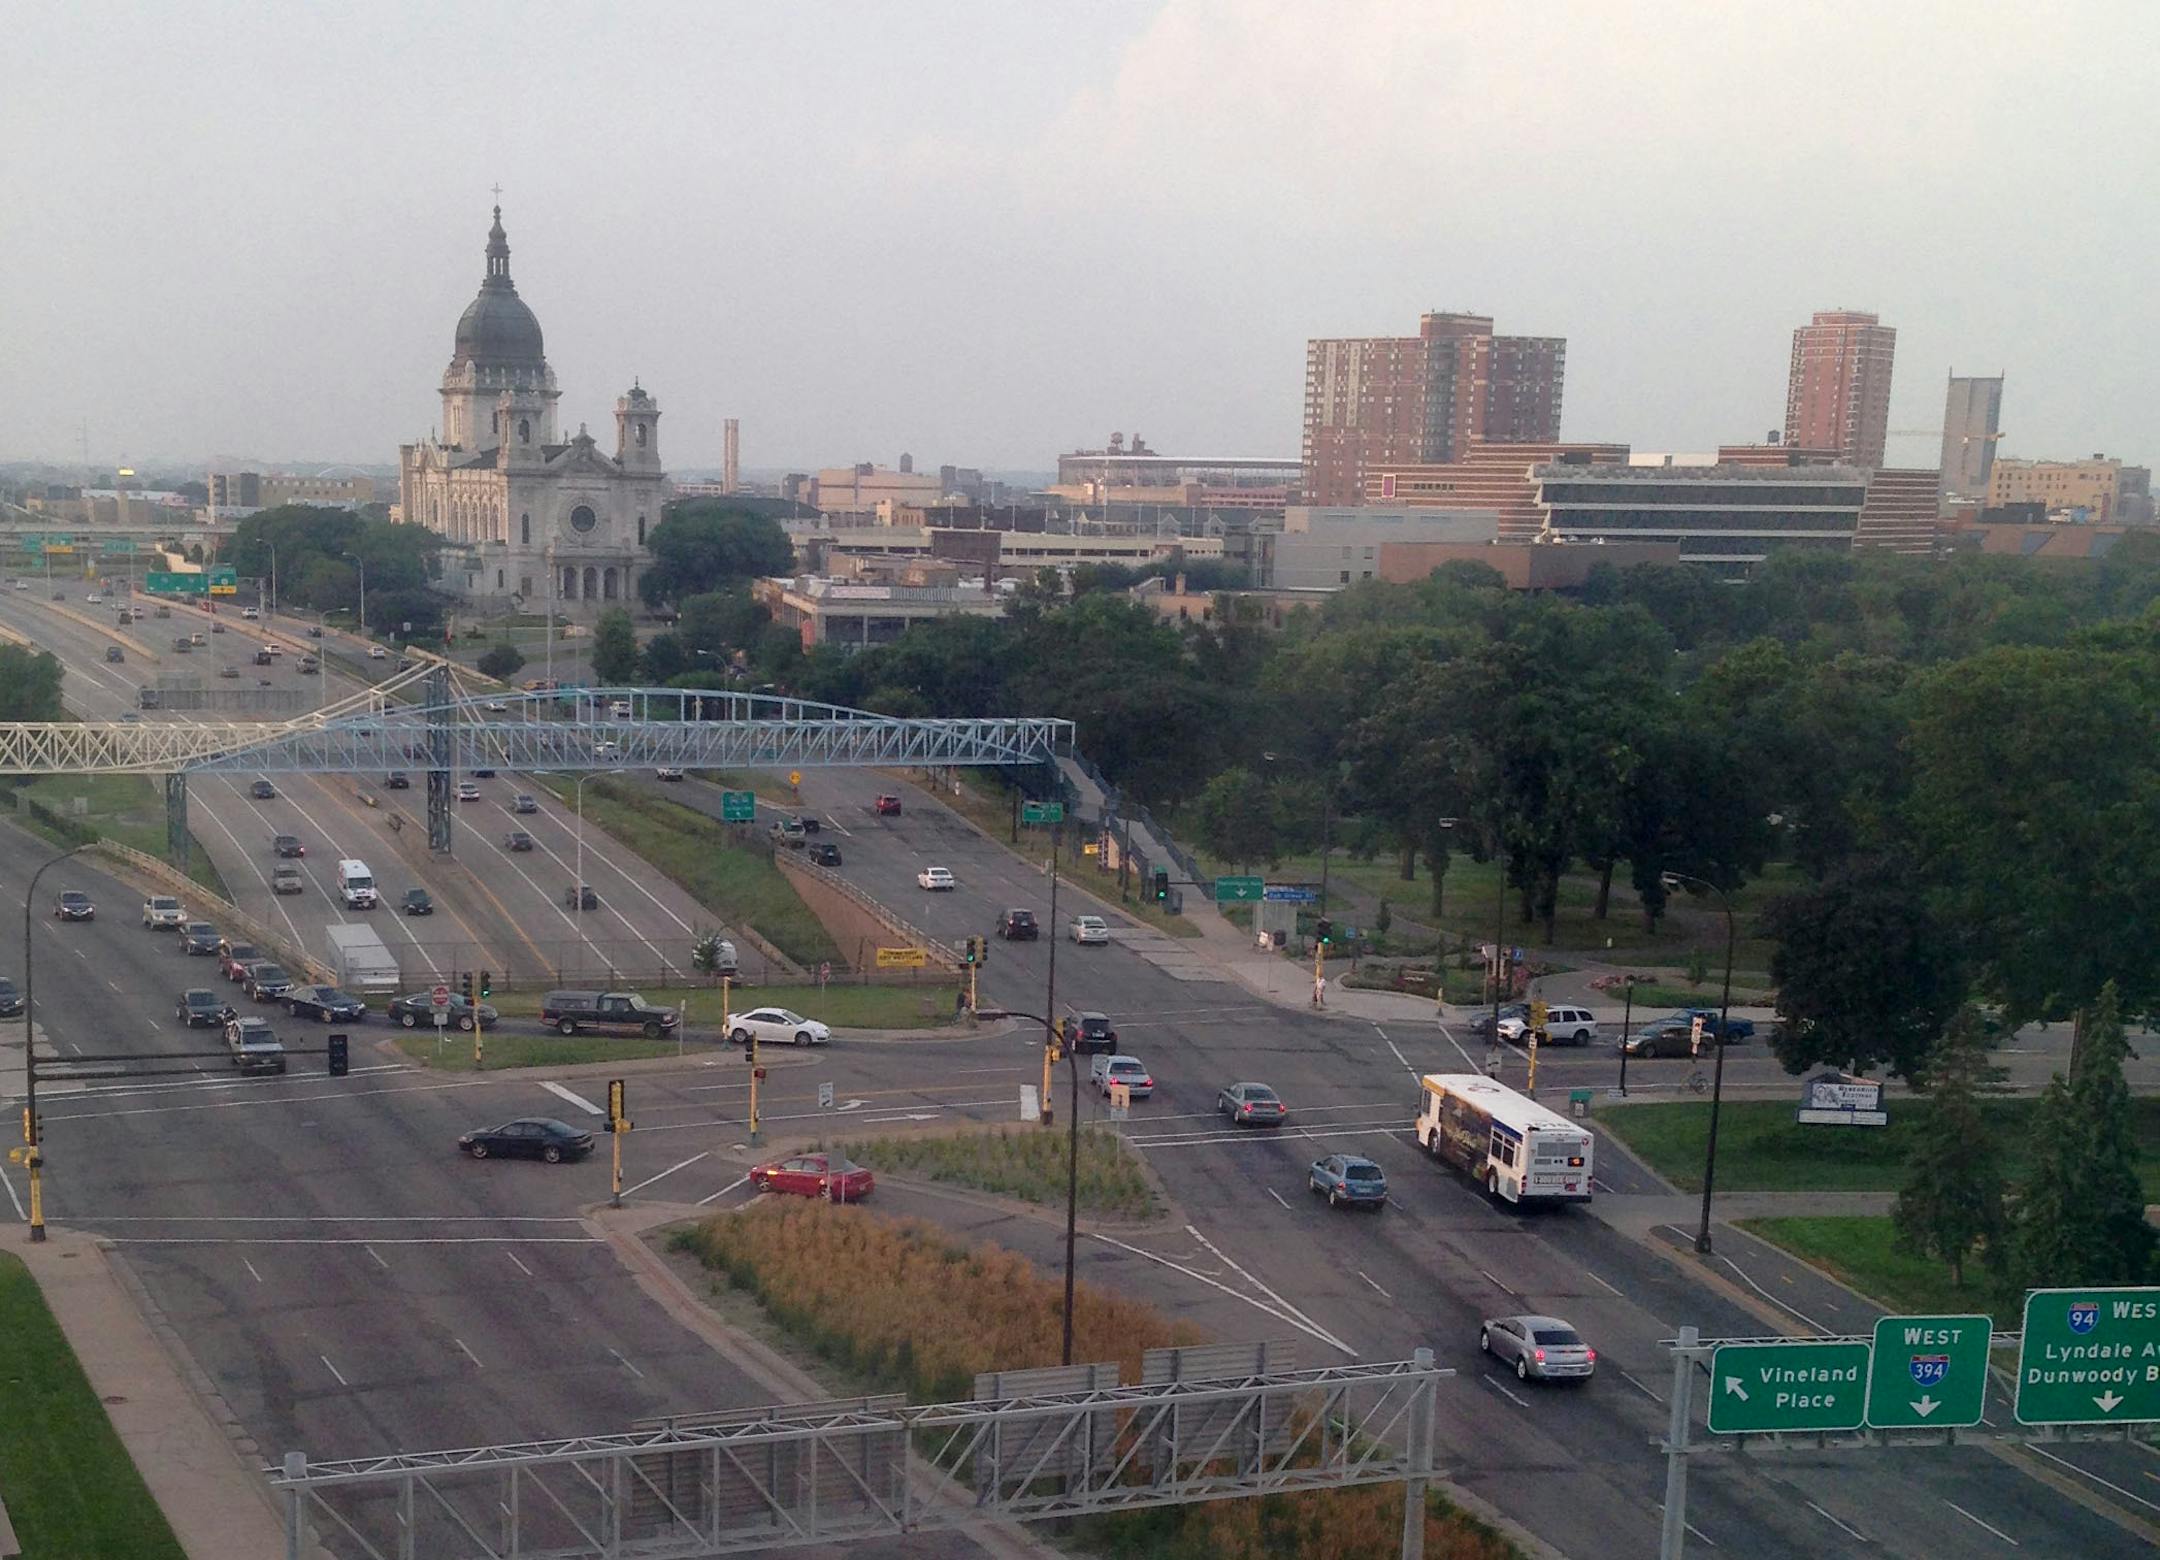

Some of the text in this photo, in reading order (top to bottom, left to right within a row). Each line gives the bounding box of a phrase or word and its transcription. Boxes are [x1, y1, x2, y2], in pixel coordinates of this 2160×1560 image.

[2072, 1311, 2094, 1326] 94
[2112, 1301, 2157, 1318] WES
[1904, 1327, 1963, 1345] WEST
[2046, 1343, 2132, 1362] Lyndale
[1760, 1366, 1858, 1384] Vineland
[1914, 1363, 1943, 1379] 394
[2028, 1365, 2160, 1386] Dunwoody B
[1776, 1392, 1836, 1408] Place
